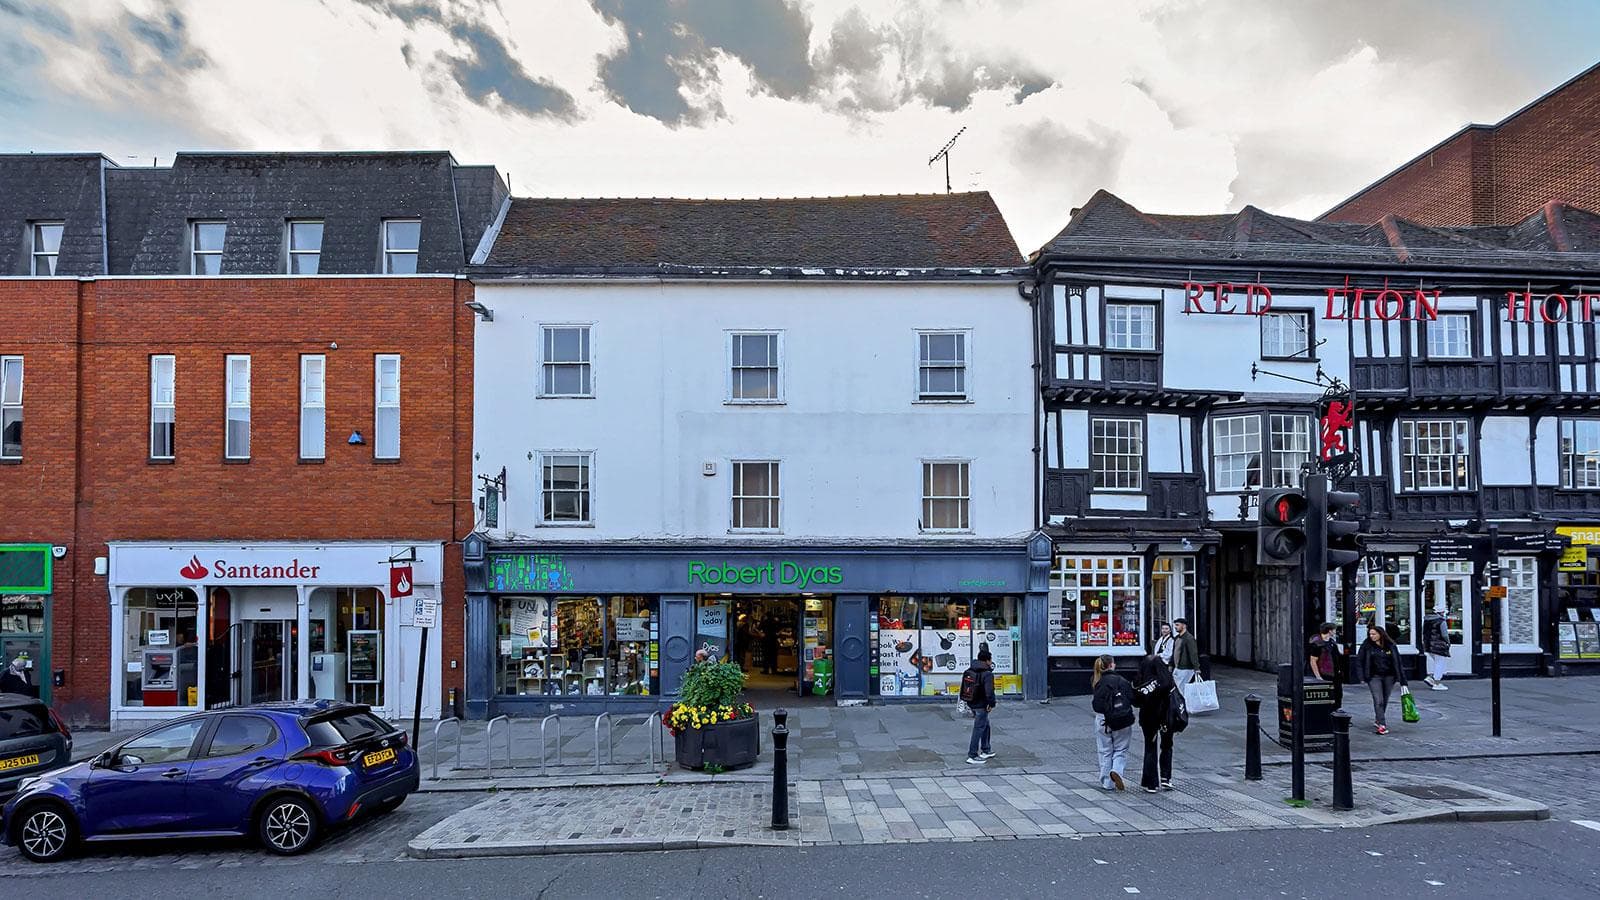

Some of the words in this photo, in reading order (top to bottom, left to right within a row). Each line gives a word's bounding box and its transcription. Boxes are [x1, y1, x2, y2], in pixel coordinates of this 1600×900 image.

[1183, 282, 1272, 316] RED
[1324, 288, 1442, 321] LION
[214, 559, 320, 578] Santander
[688, 560, 775, 584] Robert
[780, 560, 843, 588] Dyas
[704, 609, 721, 617] Join
[702, 617, 723, 625] today
[1306, 691, 1329, 699] LITTER
[0, 758, 19, 769] J25
